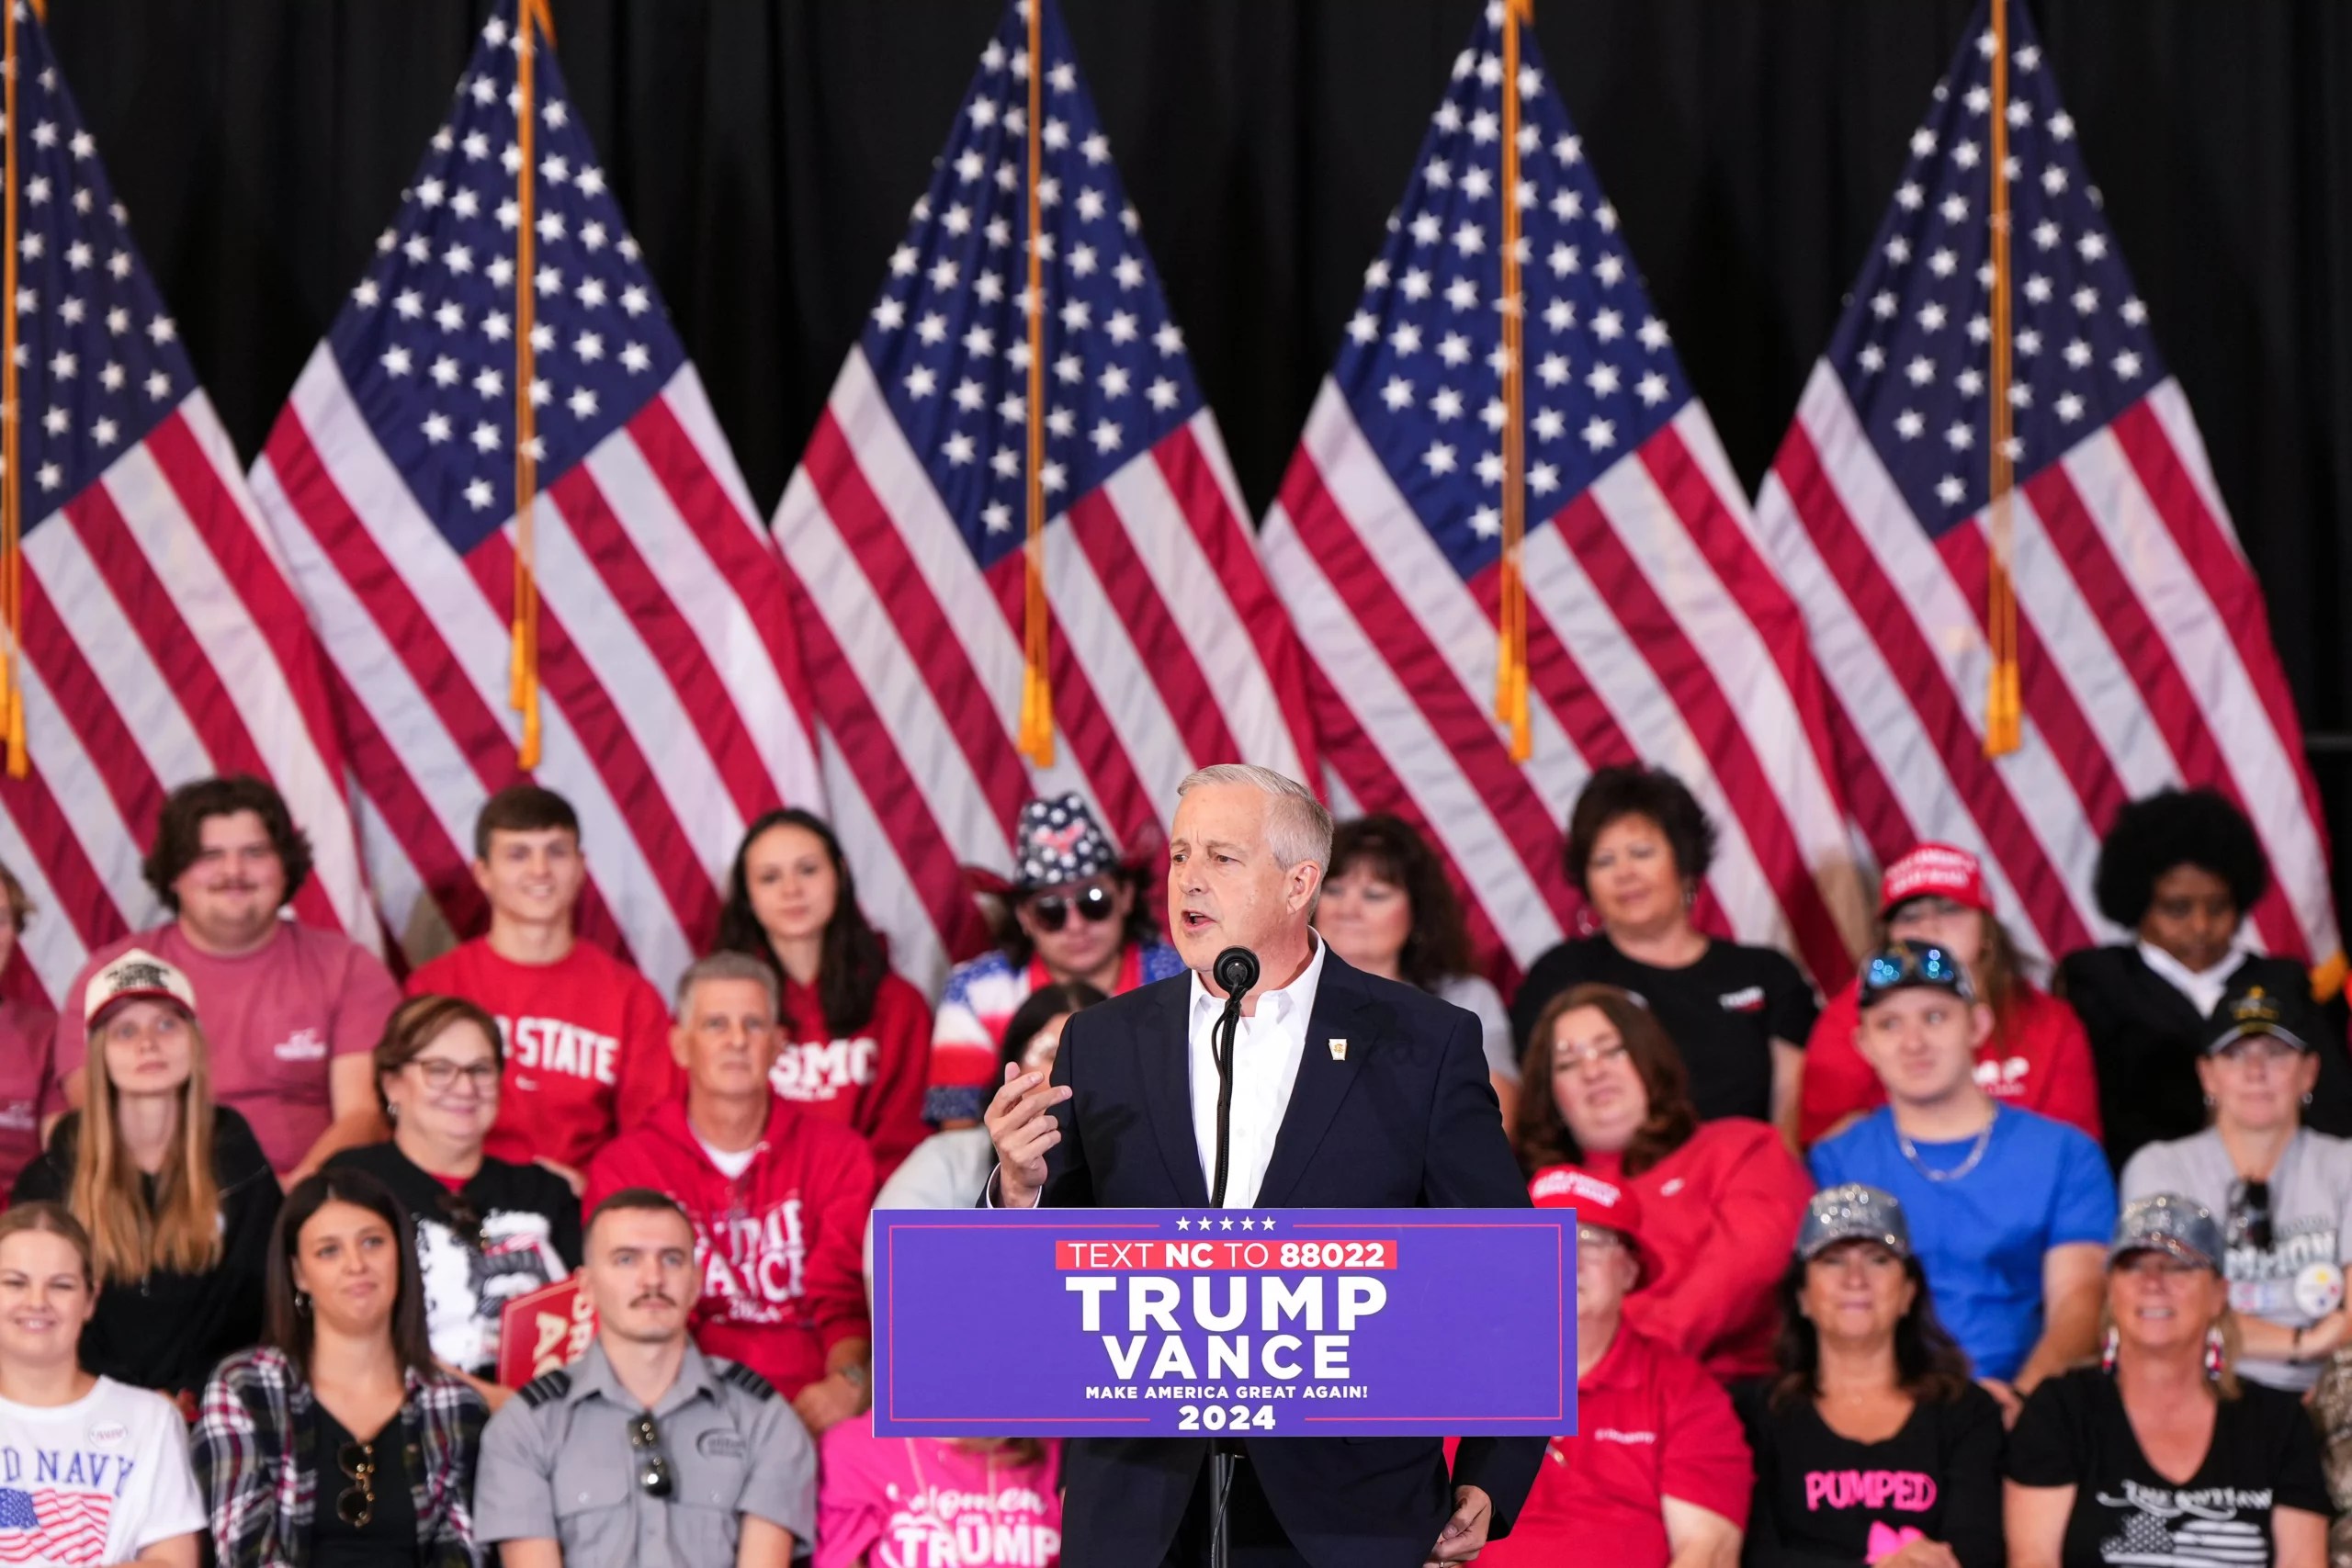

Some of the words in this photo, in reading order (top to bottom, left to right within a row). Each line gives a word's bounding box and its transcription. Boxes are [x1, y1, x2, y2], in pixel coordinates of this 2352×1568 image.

[516, 1016, 619, 1086] STATE
[1068, 1243, 1154, 1268] TEXT
[1166, 1243, 1214, 1268] NC
[1224, 1243, 1269, 1268] TO
[1280, 1242, 1385, 1268] 88022
[1066, 1275, 1387, 1332] TRUMP
[1102, 1335, 1351, 1380] VANCE
[1085, 1386, 1138, 1399] MAKE
[1144, 1386, 1229, 1399] AMERICA
[1236, 1385, 1296, 1399] GREAT
[1303, 1385, 1368, 1399] AGAIN!
[1178, 1404, 1276, 1430] 2024
[36, 1447, 134, 1498] NAVY
[1804, 1470, 1938, 1512] PUMPED
[894, 1524, 1060, 1568] TRUMP
